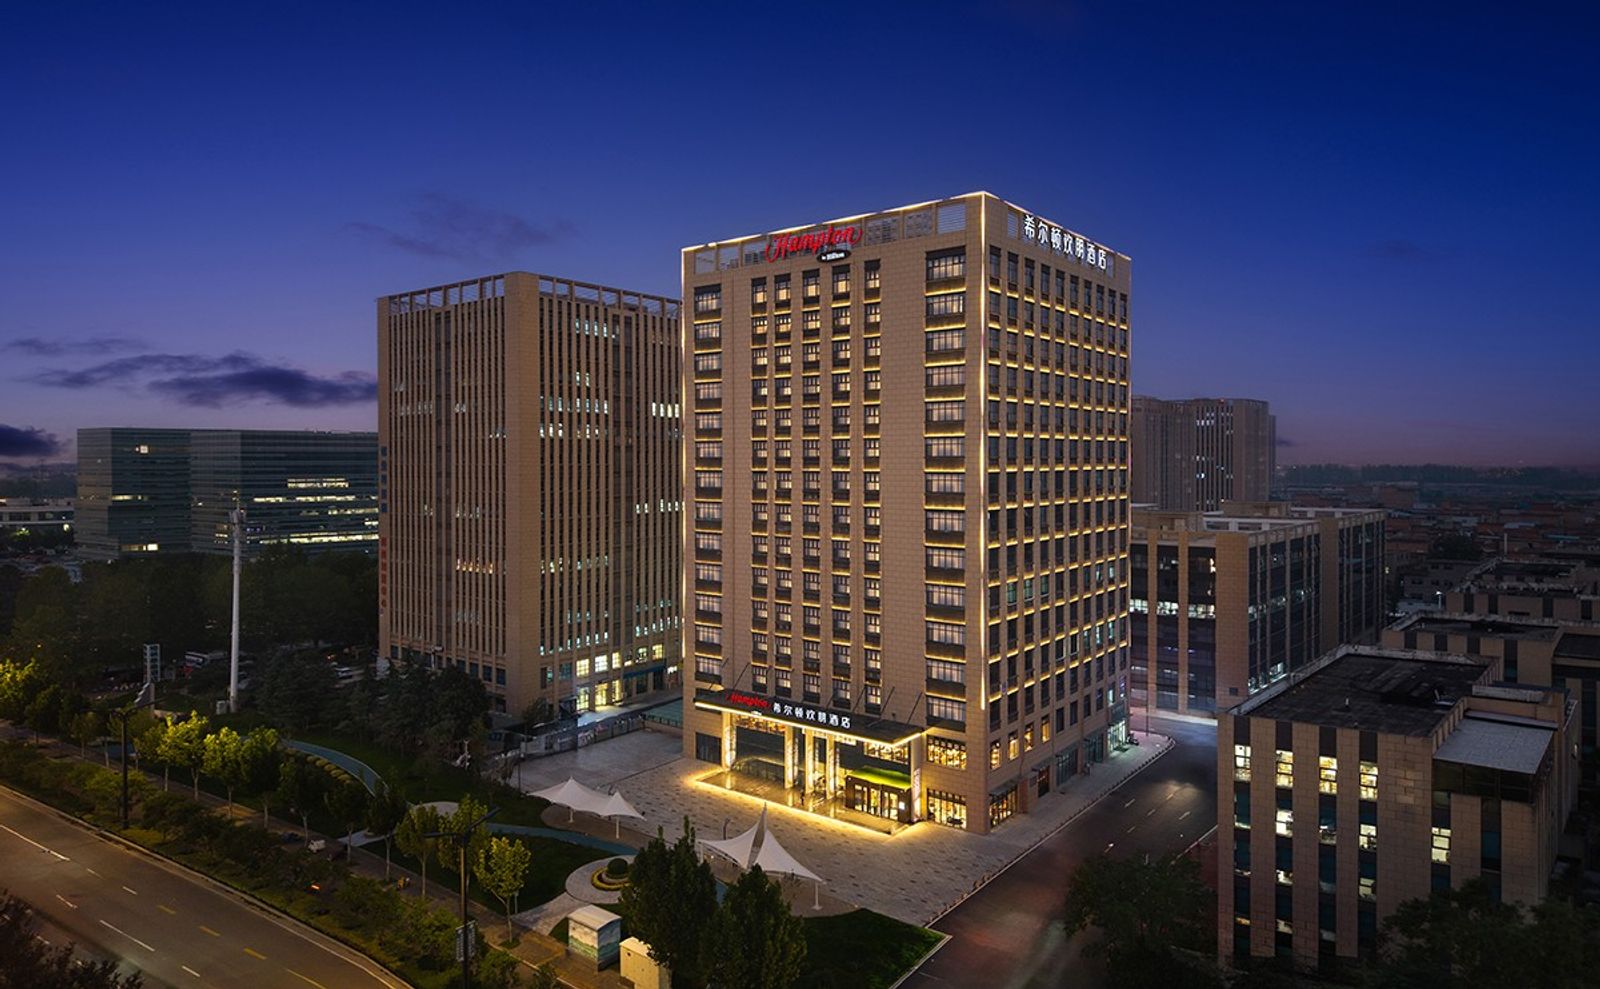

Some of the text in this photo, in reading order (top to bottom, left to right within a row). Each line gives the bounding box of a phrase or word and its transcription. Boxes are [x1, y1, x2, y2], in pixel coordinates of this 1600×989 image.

[765, 225, 863, 263] Hampton
[1024, 214, 1107, 270] 希尔顿欢朋酒店
[773, 702, 851, 729] 希尔顿欢朋酒店
